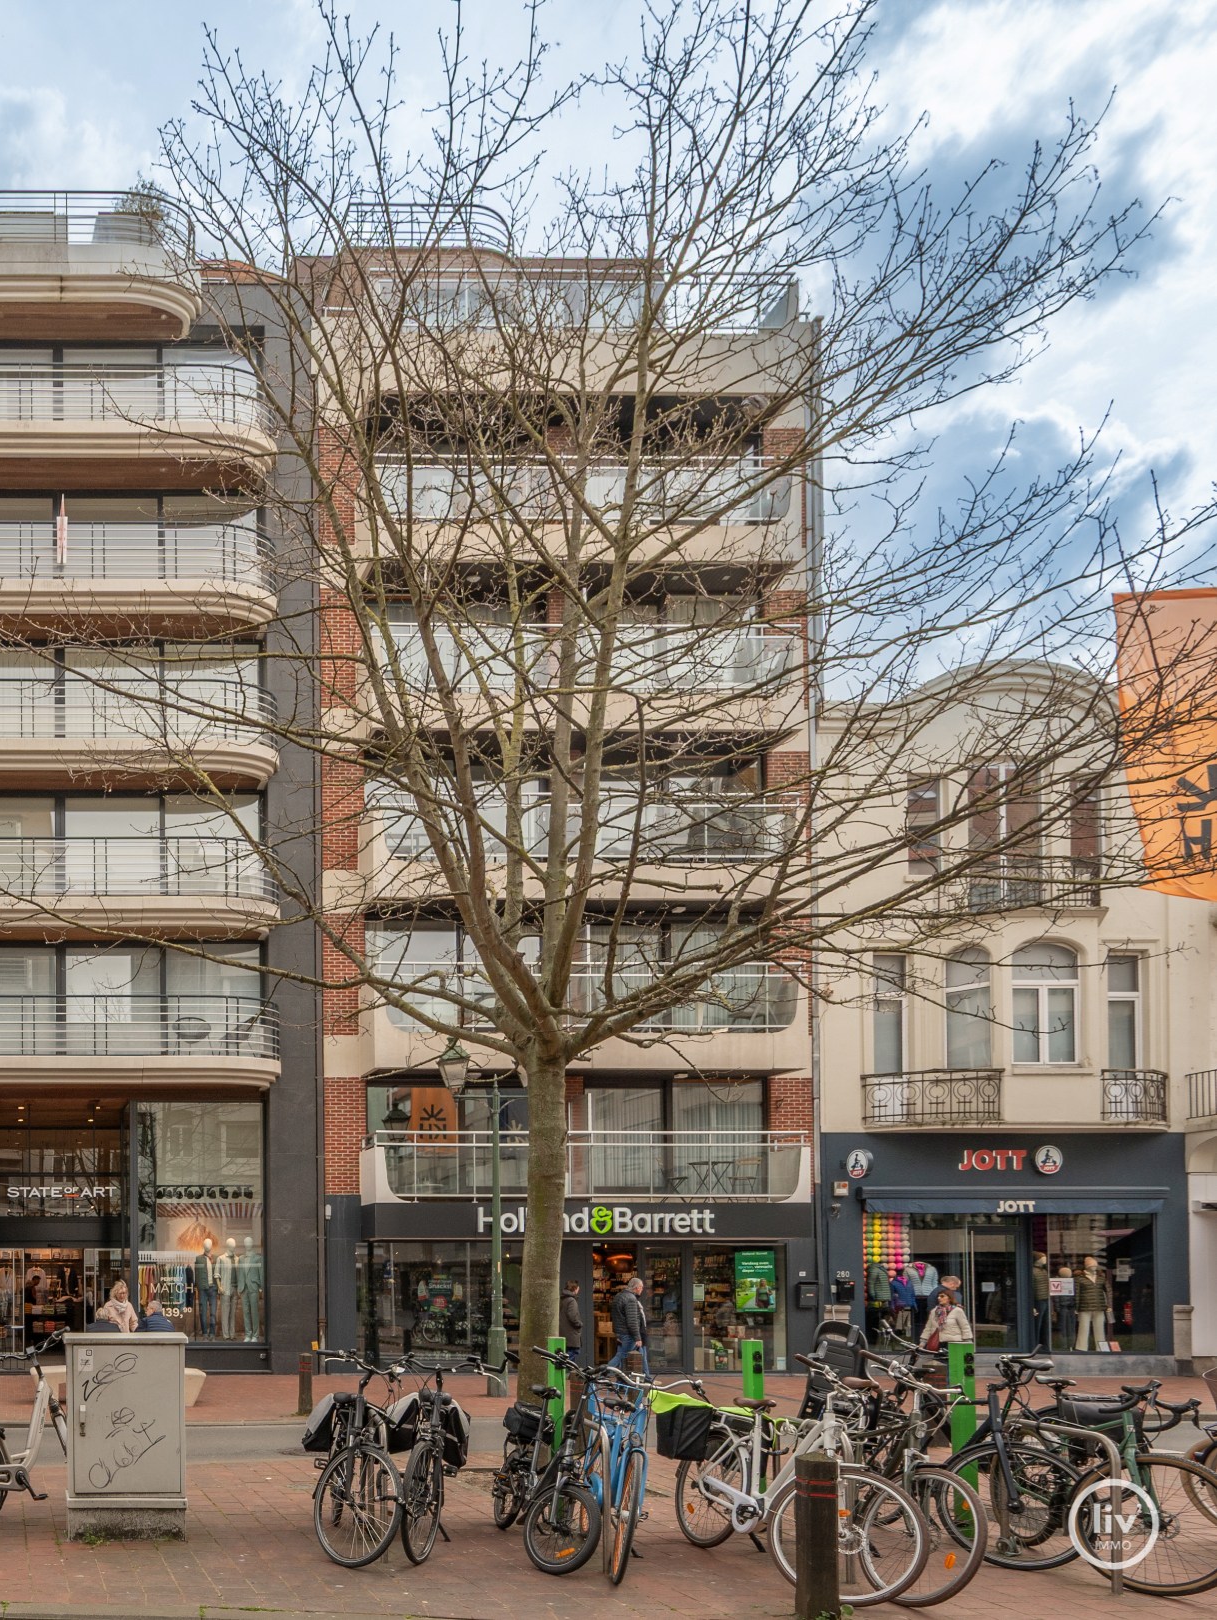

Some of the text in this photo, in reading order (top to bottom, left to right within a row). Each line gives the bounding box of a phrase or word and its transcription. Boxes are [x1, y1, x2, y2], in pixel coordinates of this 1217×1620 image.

[958, 1149, 1027, 1171] JOTT
[6, 1186, 117, 1198] STATE OF ART
[996, 1200, 1036, 1213] JOTT
[150, 1282, 194, 1294] MATCH
